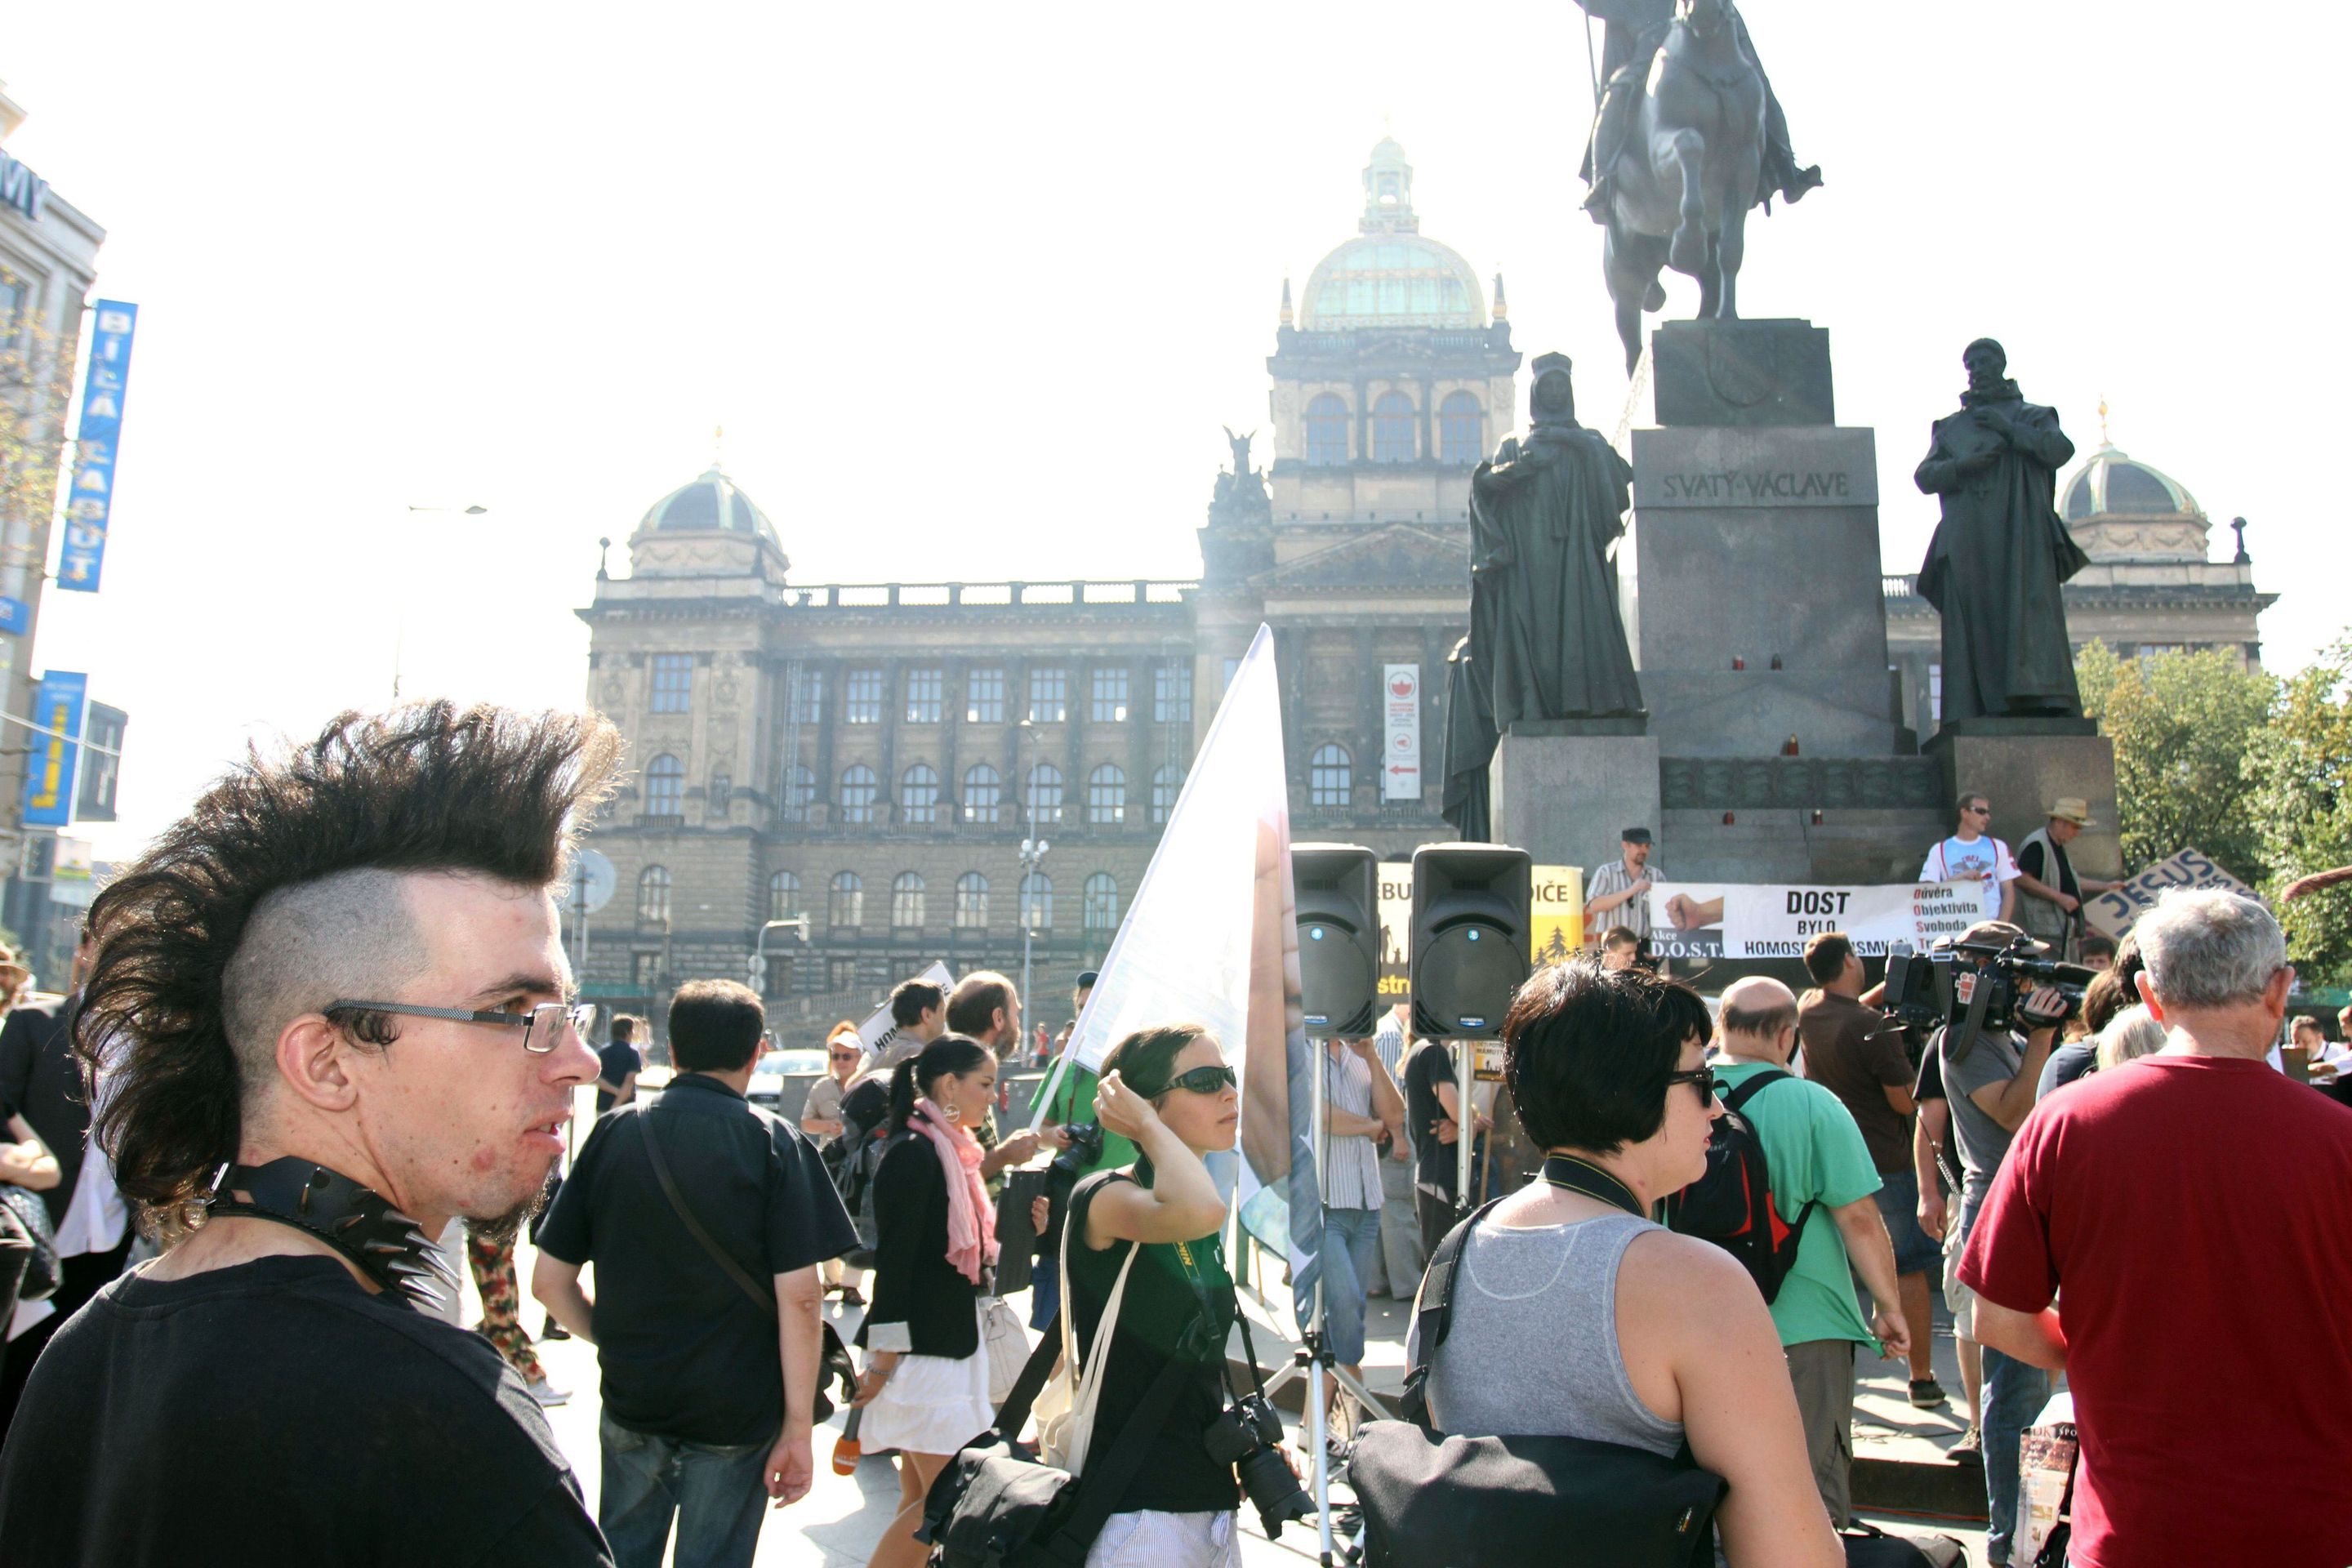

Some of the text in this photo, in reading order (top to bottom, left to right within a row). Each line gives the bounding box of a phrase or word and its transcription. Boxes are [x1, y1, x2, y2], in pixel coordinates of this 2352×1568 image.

[1379, 880, 1568, 902] BU IČE
[2100, 850, 2215, 920] JESUS
[1786, 891, 1851, 915] DOST
[1913, 902, 1978, 916] Objektivita
[1916, 920, 1967, 933] Svoboda
[1652, 930, 1677, 941] Akce
[1651, 942, 1724, 958] D.O.S.T.
